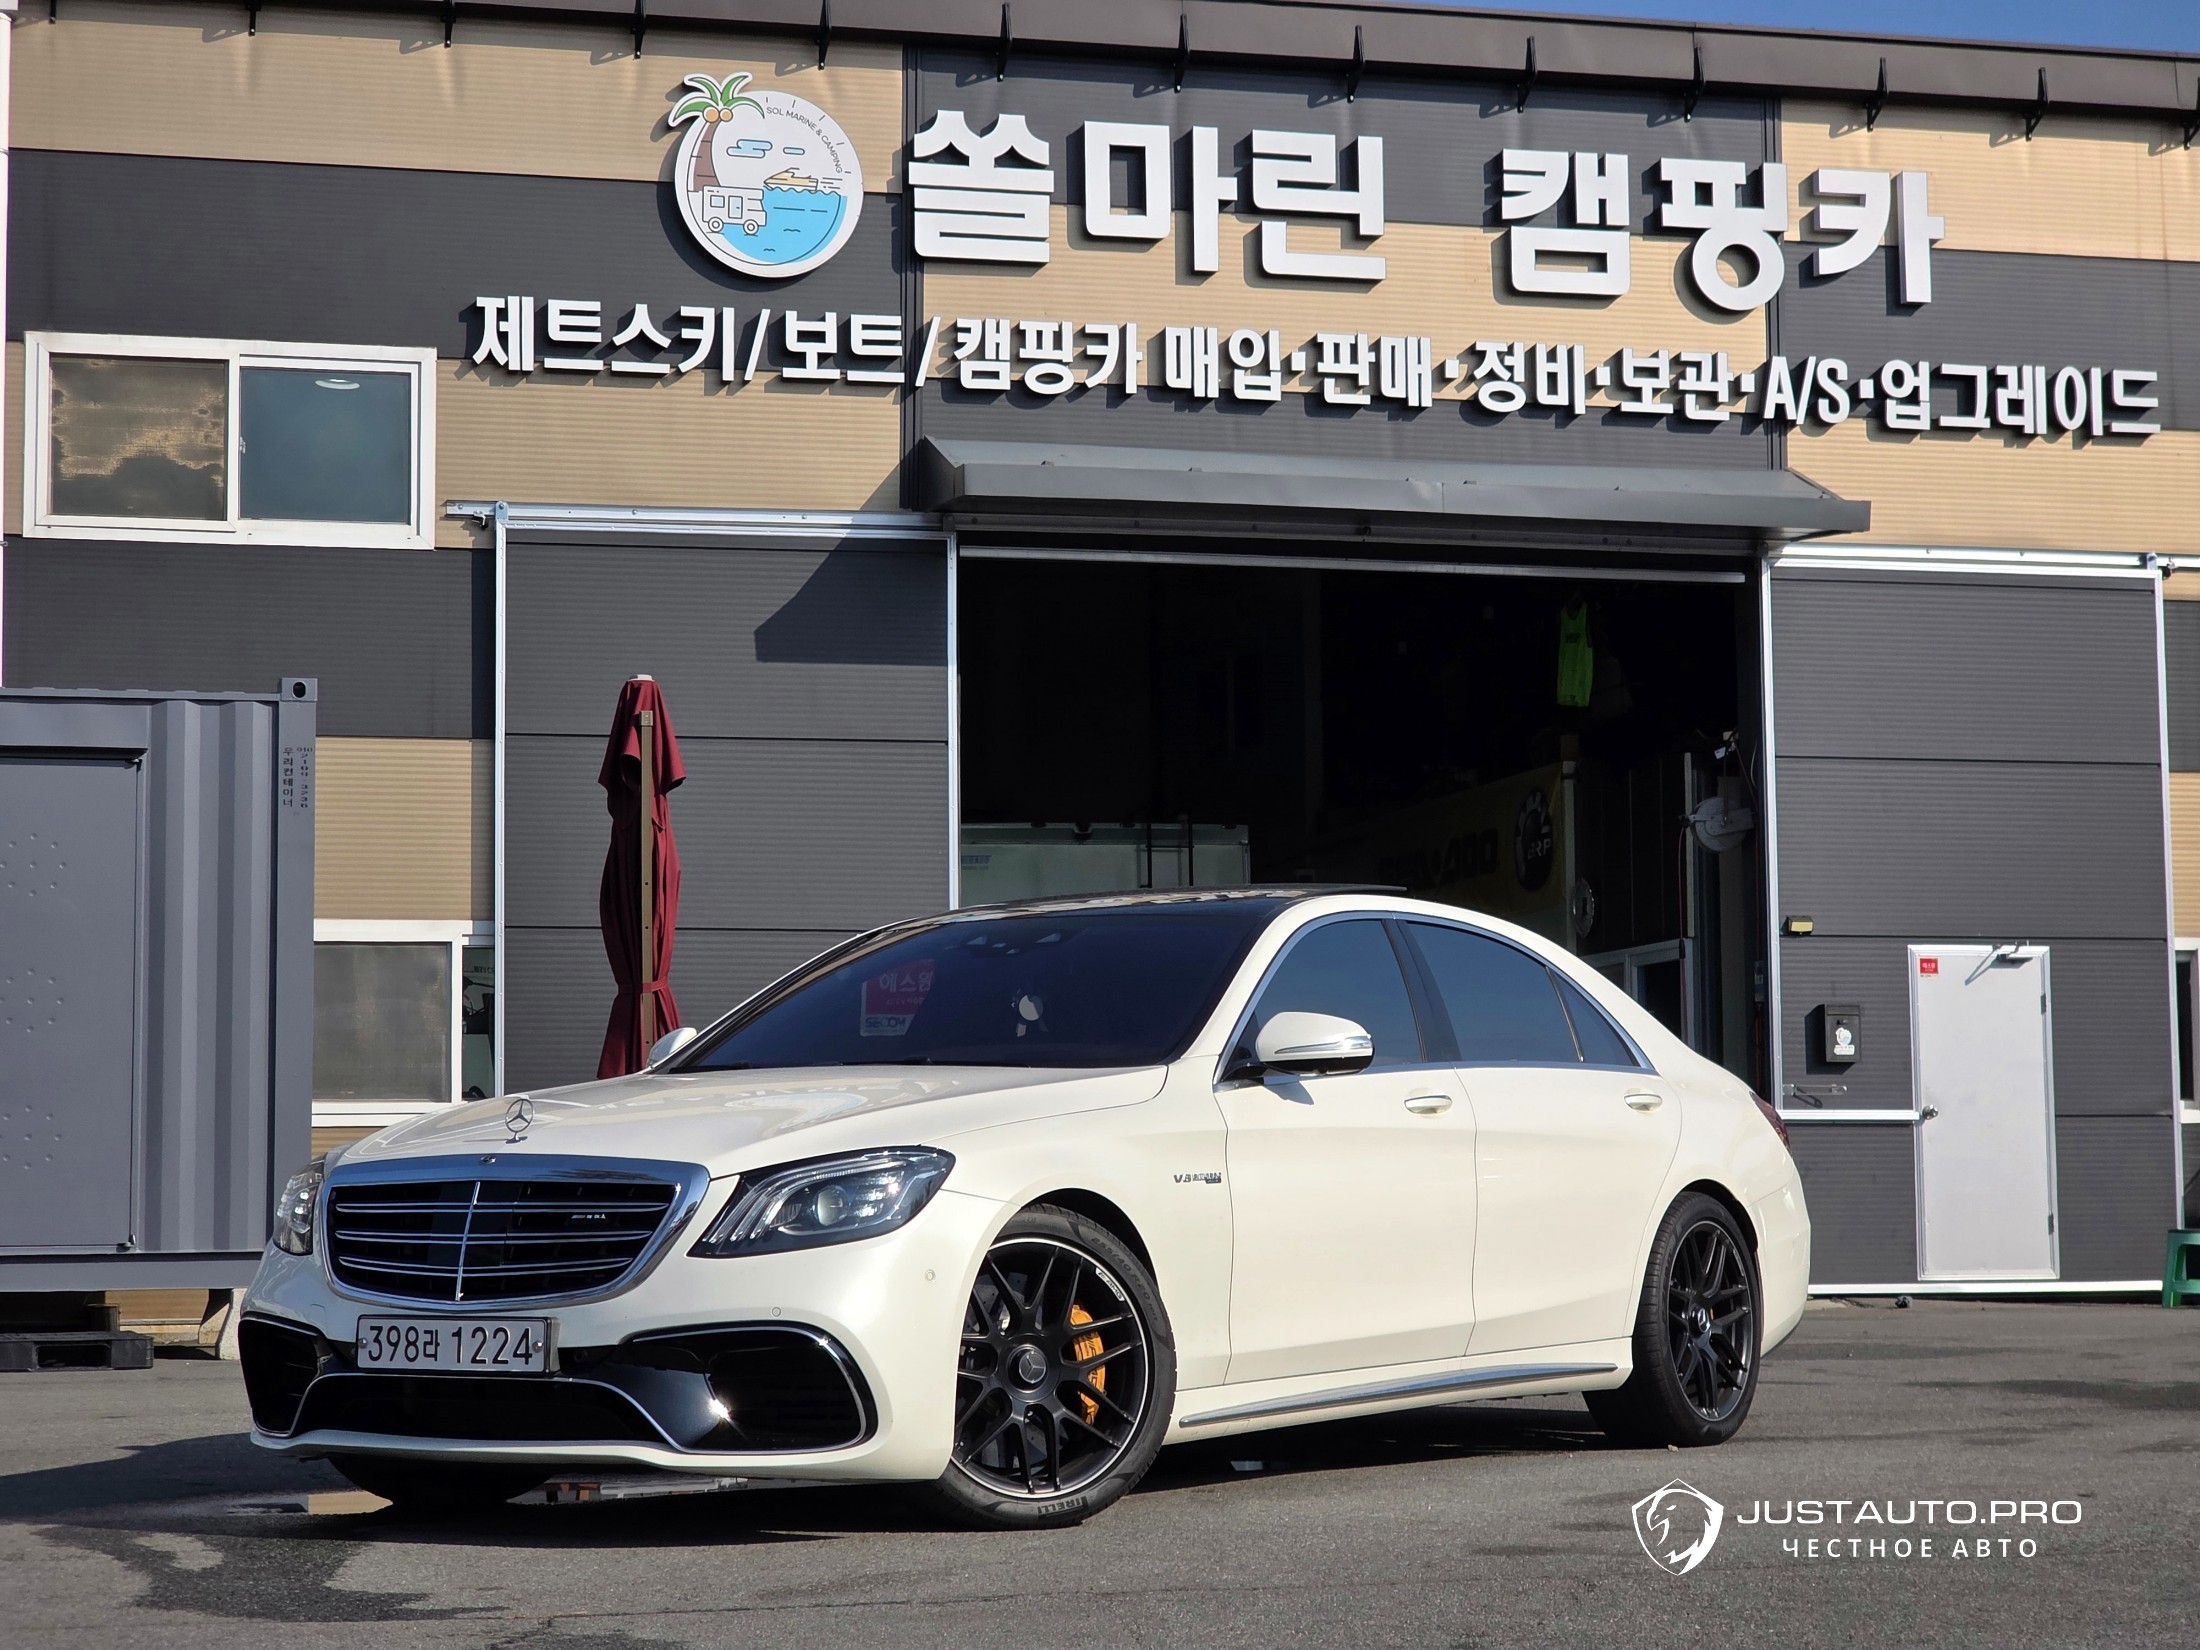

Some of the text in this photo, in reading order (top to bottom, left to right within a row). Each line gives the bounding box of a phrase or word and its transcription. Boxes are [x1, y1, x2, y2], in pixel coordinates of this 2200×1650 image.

[766, 106, 843, 174] SOL MARINE & CAMPING
[908, 110, 1945, 311] 쏠마린 캠핑카
[472, 295, 1144, 394] 제트스키/보트/캠핑카
[368, 1325, 533, 1365] 398라 1224
